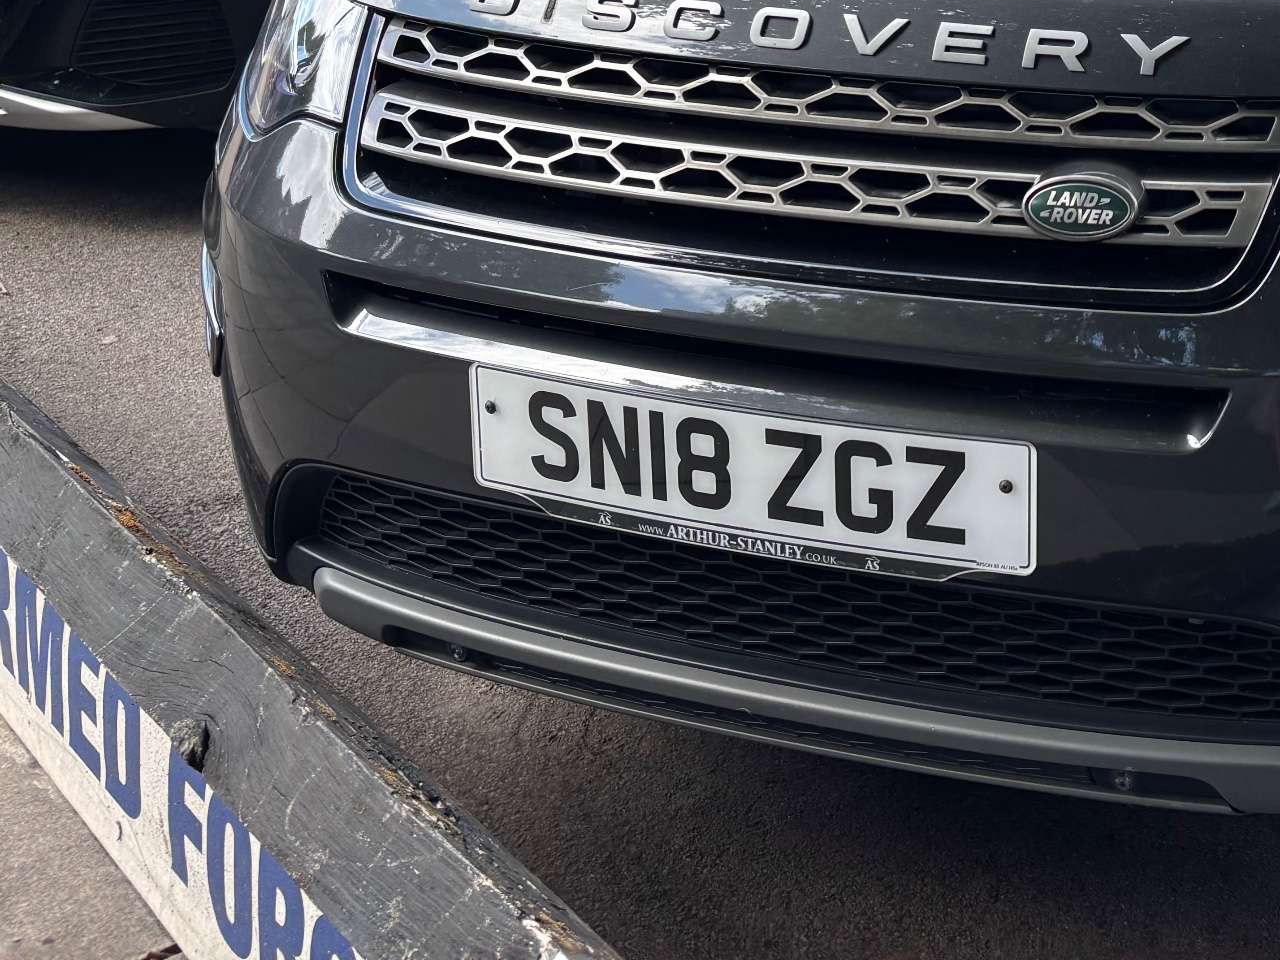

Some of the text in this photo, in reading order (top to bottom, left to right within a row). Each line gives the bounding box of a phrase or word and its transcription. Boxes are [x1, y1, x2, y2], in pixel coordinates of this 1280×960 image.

[1047, 191, 1099, 207] LAND
[1050, 208, 1113, 225] ROVER
[527, 390, 966, 545] SN18 ZGZ
